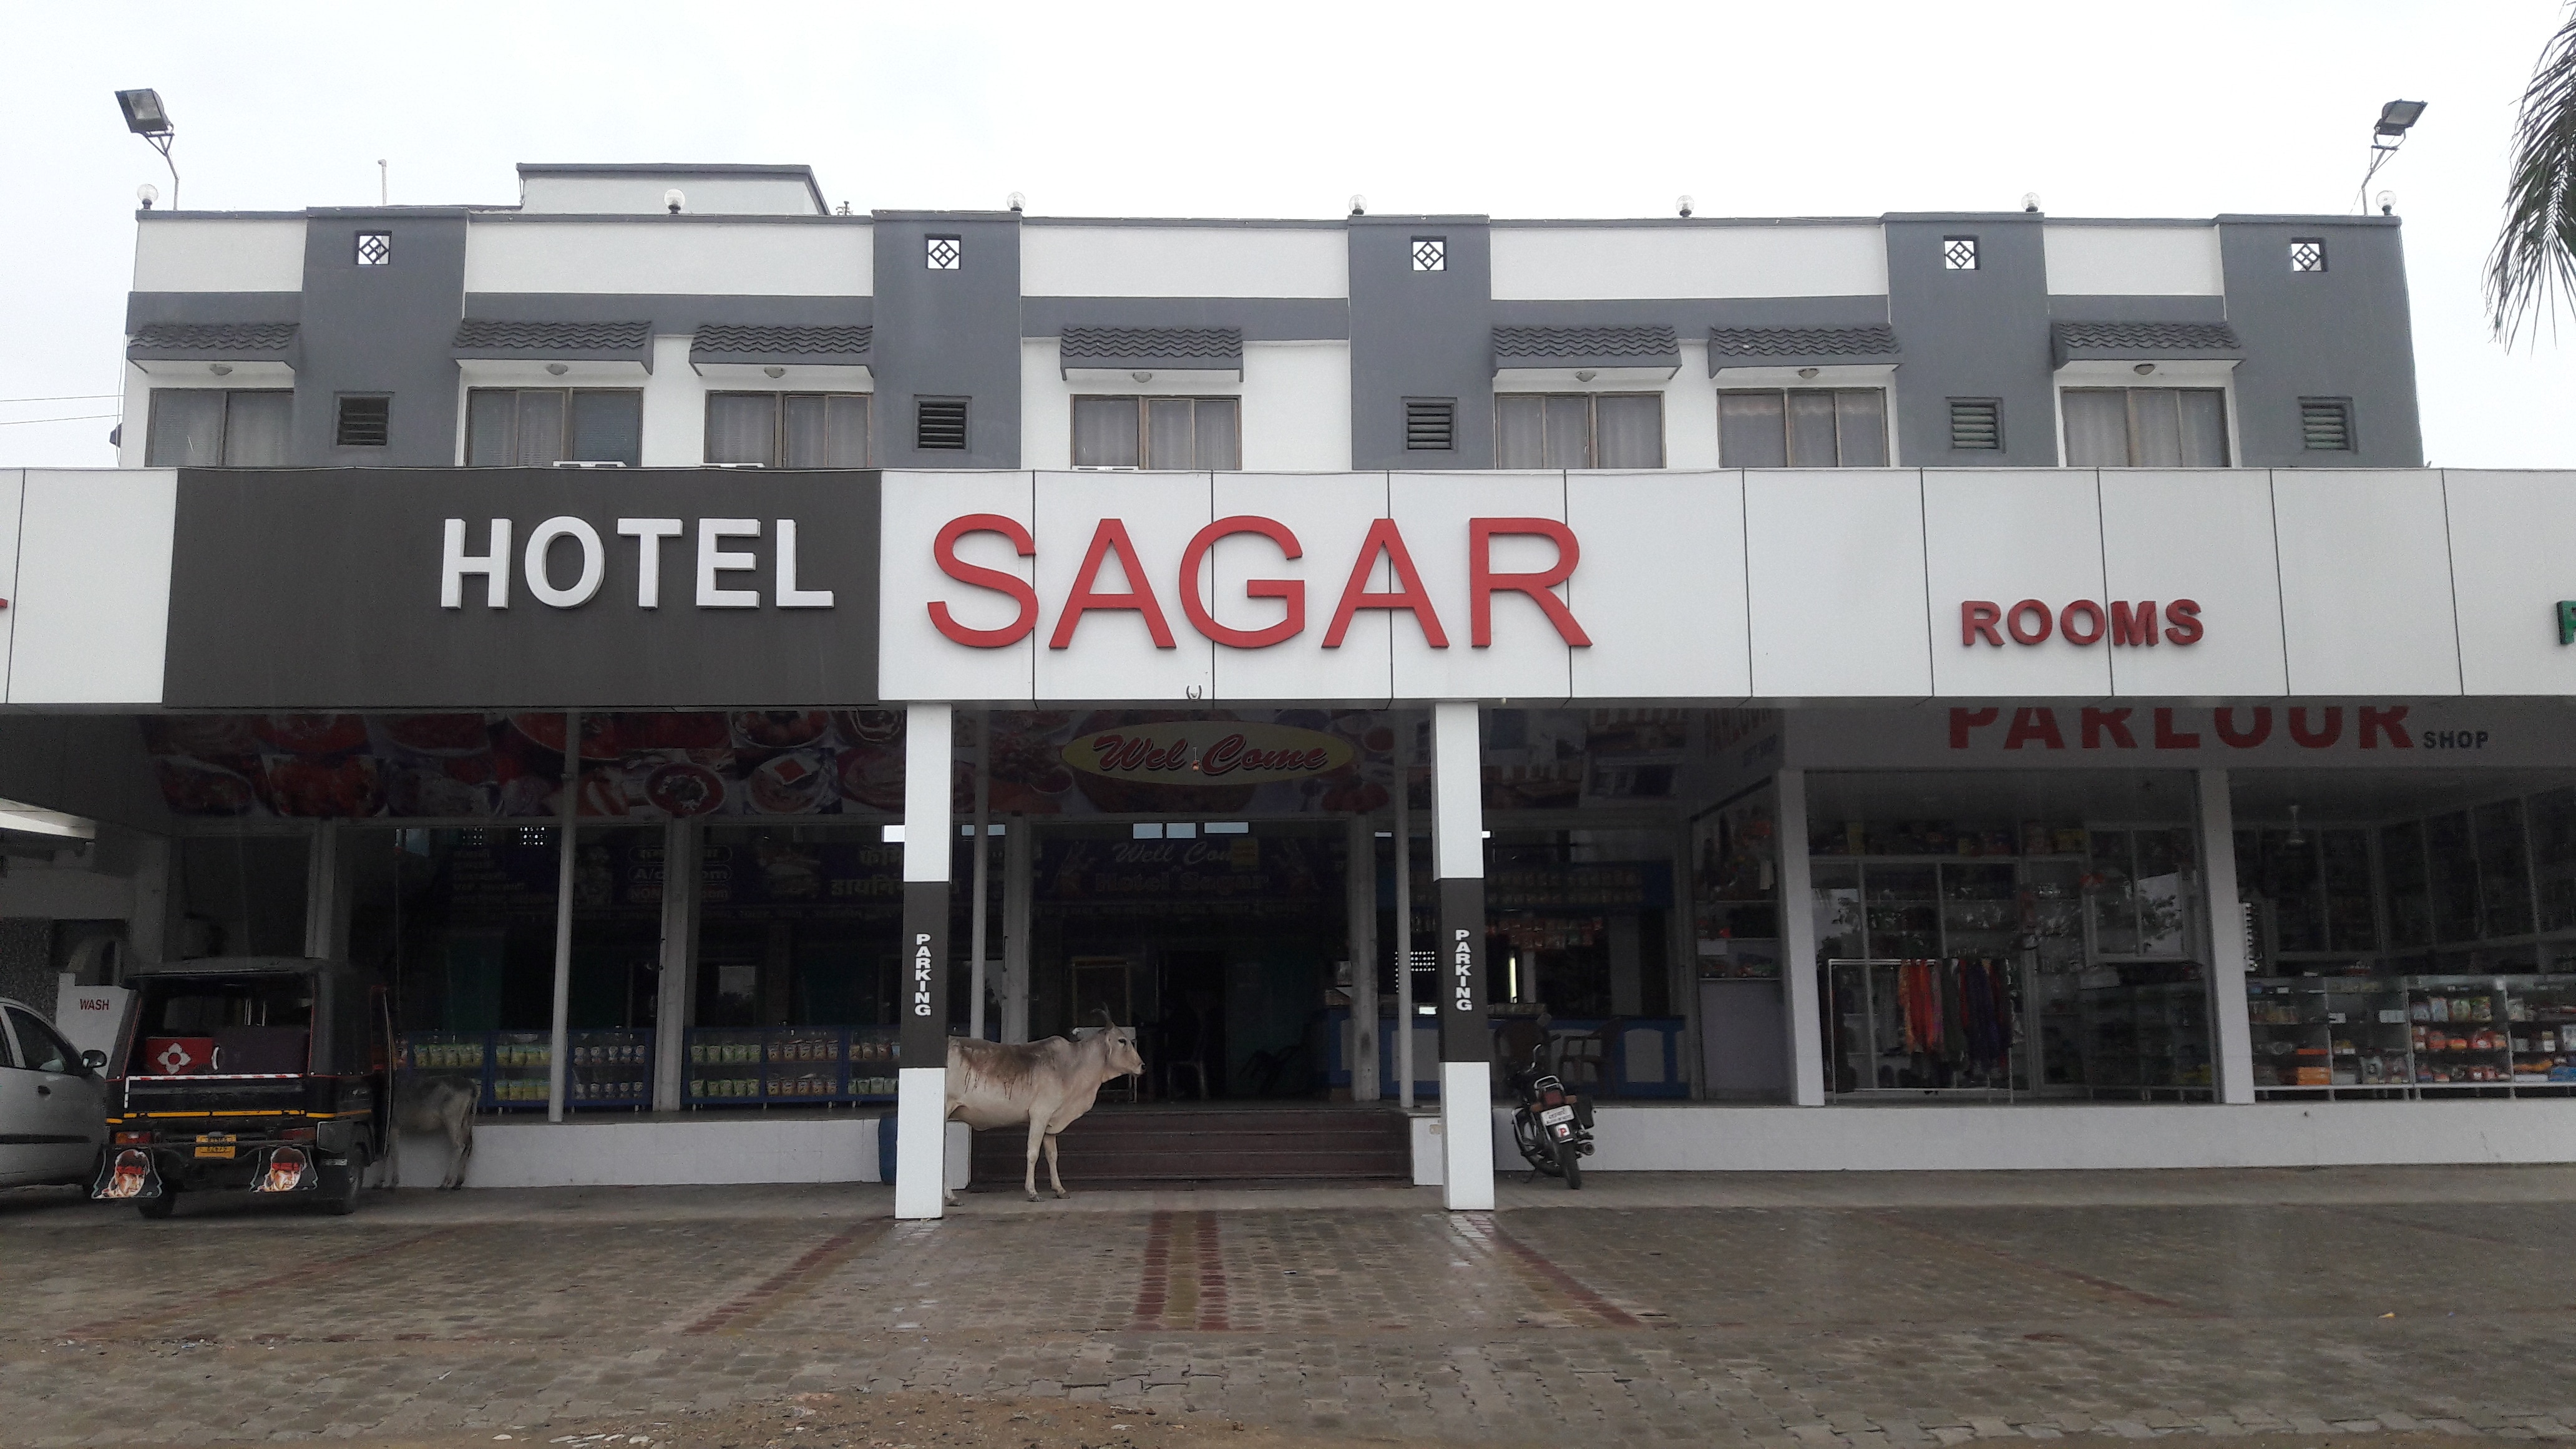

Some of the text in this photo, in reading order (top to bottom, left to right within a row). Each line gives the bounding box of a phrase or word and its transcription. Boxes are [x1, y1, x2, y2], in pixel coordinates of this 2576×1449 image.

[441, 514, 1593, 650] HOTEL SAGAR
[1961, 599, 2203, 646] ROOMS
[1949, 706, 2489, 749] PARLOUR SHOP
[1093, 734, 1327, 776] Wel Come
[1111, 842, 1175, 862] Well
[1095, 871, 1170, 894] Hotel
[915, 933, 932, 1016] PARKING
[1455, 929, 1473, 1011] PARKING
[80, 998, 110, 1010] WASH
